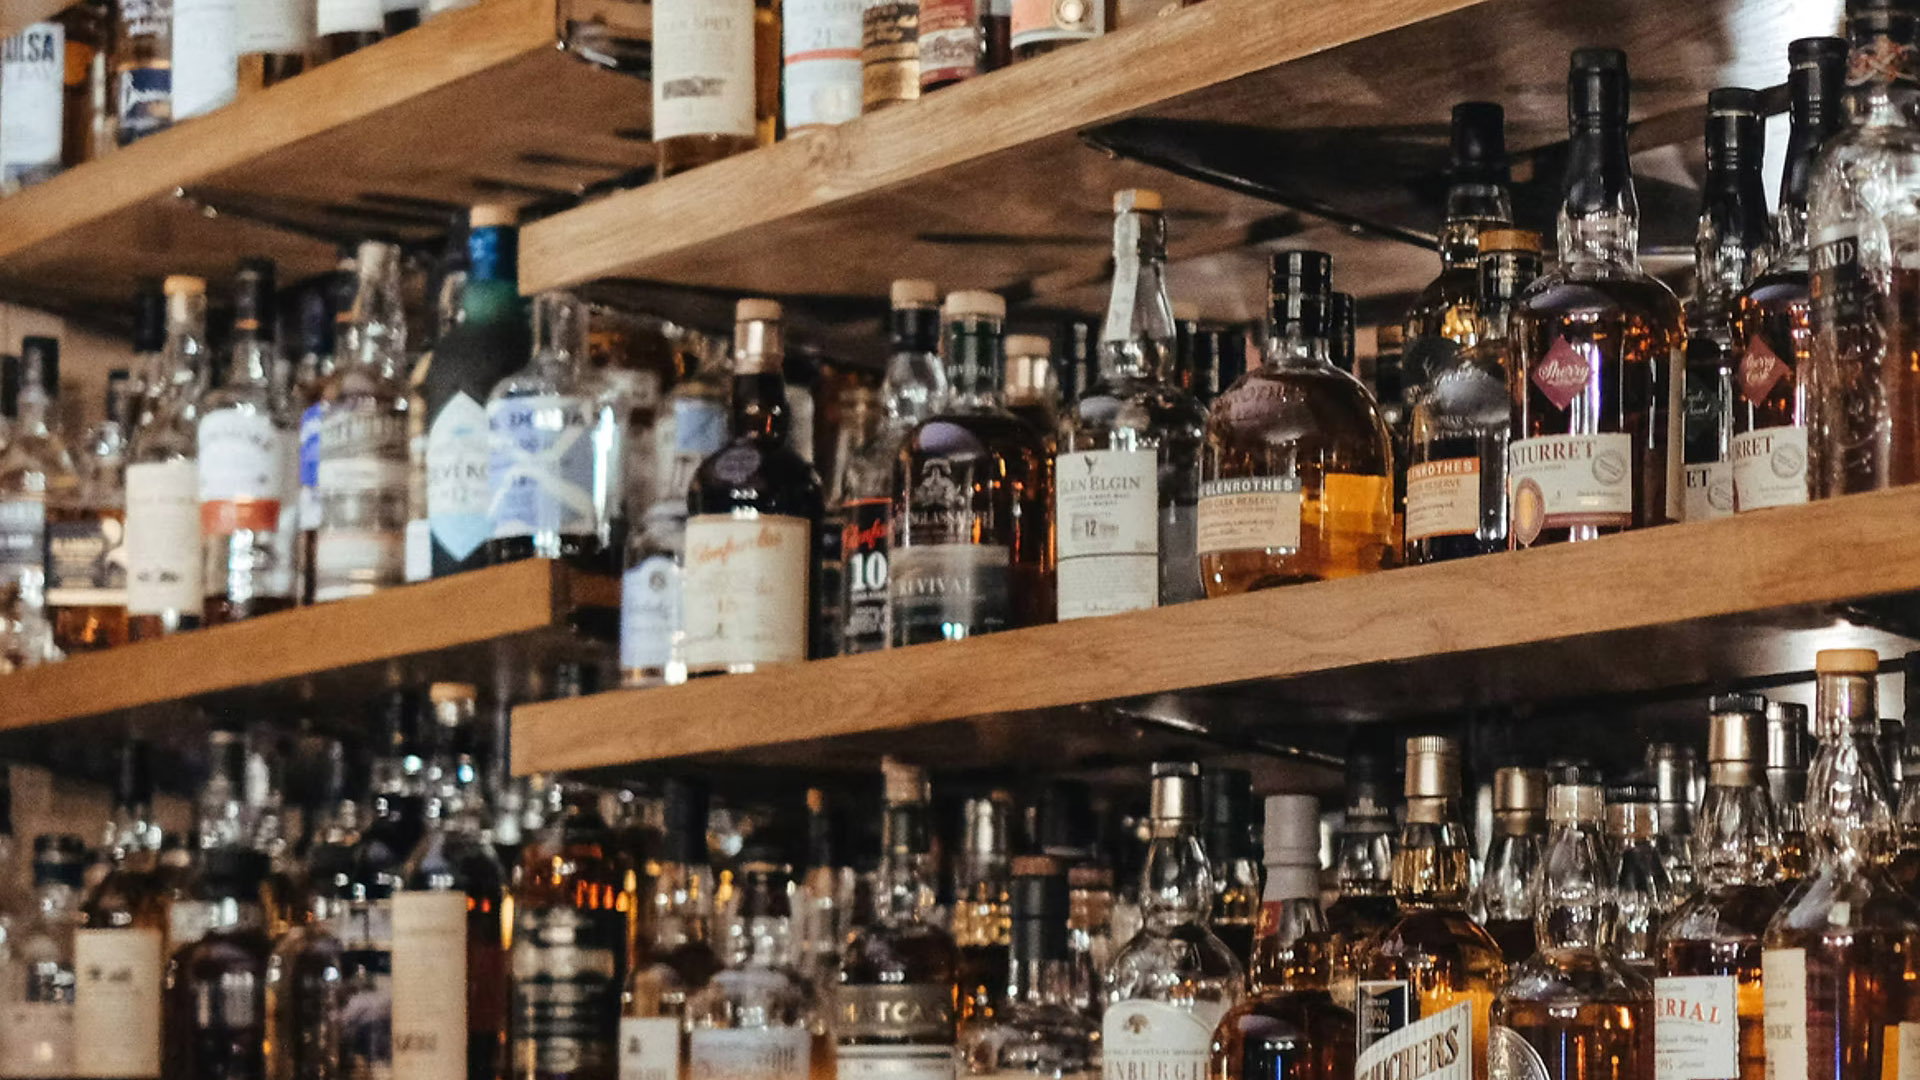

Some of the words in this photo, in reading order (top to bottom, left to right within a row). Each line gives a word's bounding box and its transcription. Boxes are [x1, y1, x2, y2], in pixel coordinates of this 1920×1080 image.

[1538, 359, 1590, 384] Sherry
[1090, 475, 1142, 491] ELGIN
[1085, 518, 1097, 537] 12
[850, 551, 887, 592] 10
